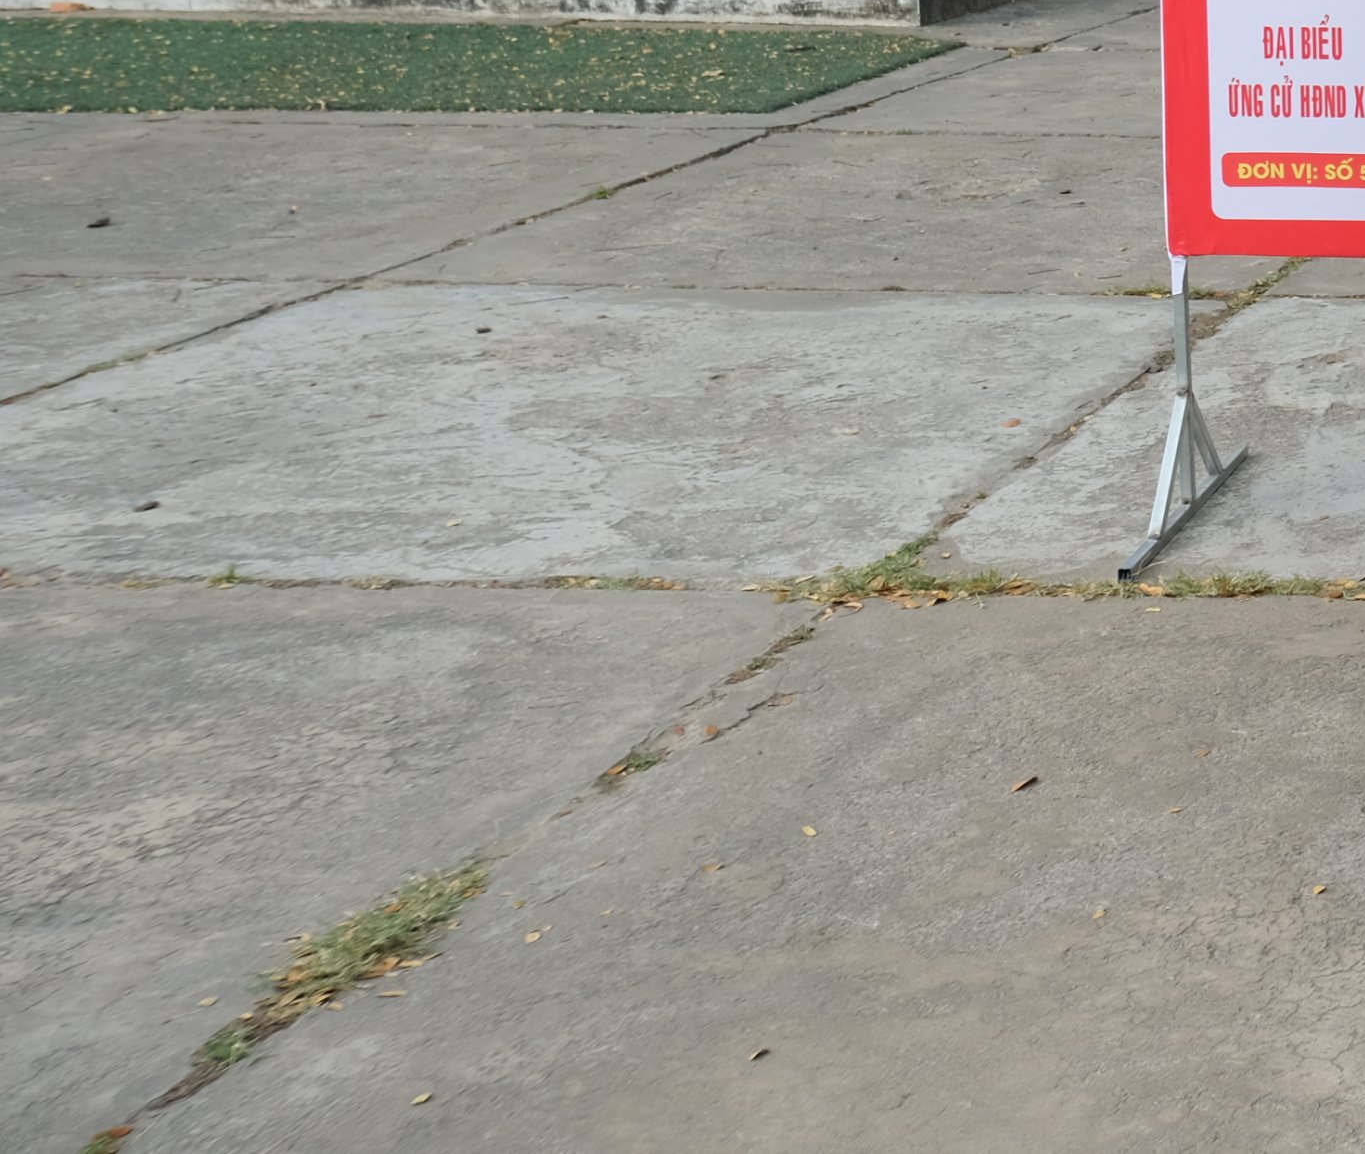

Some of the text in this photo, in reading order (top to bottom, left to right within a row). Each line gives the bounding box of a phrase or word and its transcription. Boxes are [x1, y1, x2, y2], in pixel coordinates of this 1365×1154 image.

[1263, 14, 1344, 66] ĐẠI BIỂU
[1228, 77, 1264, 118] ỨNG
[1270, 75, 1293, 119] CỬ
[1300, 85, 1347, 118] HĐND
[1237, 161, 1285, 180] ĐƠN
[1291, 163, 1319, 184] VỊ:
[1324, 158, 1354, 181] SỐ
